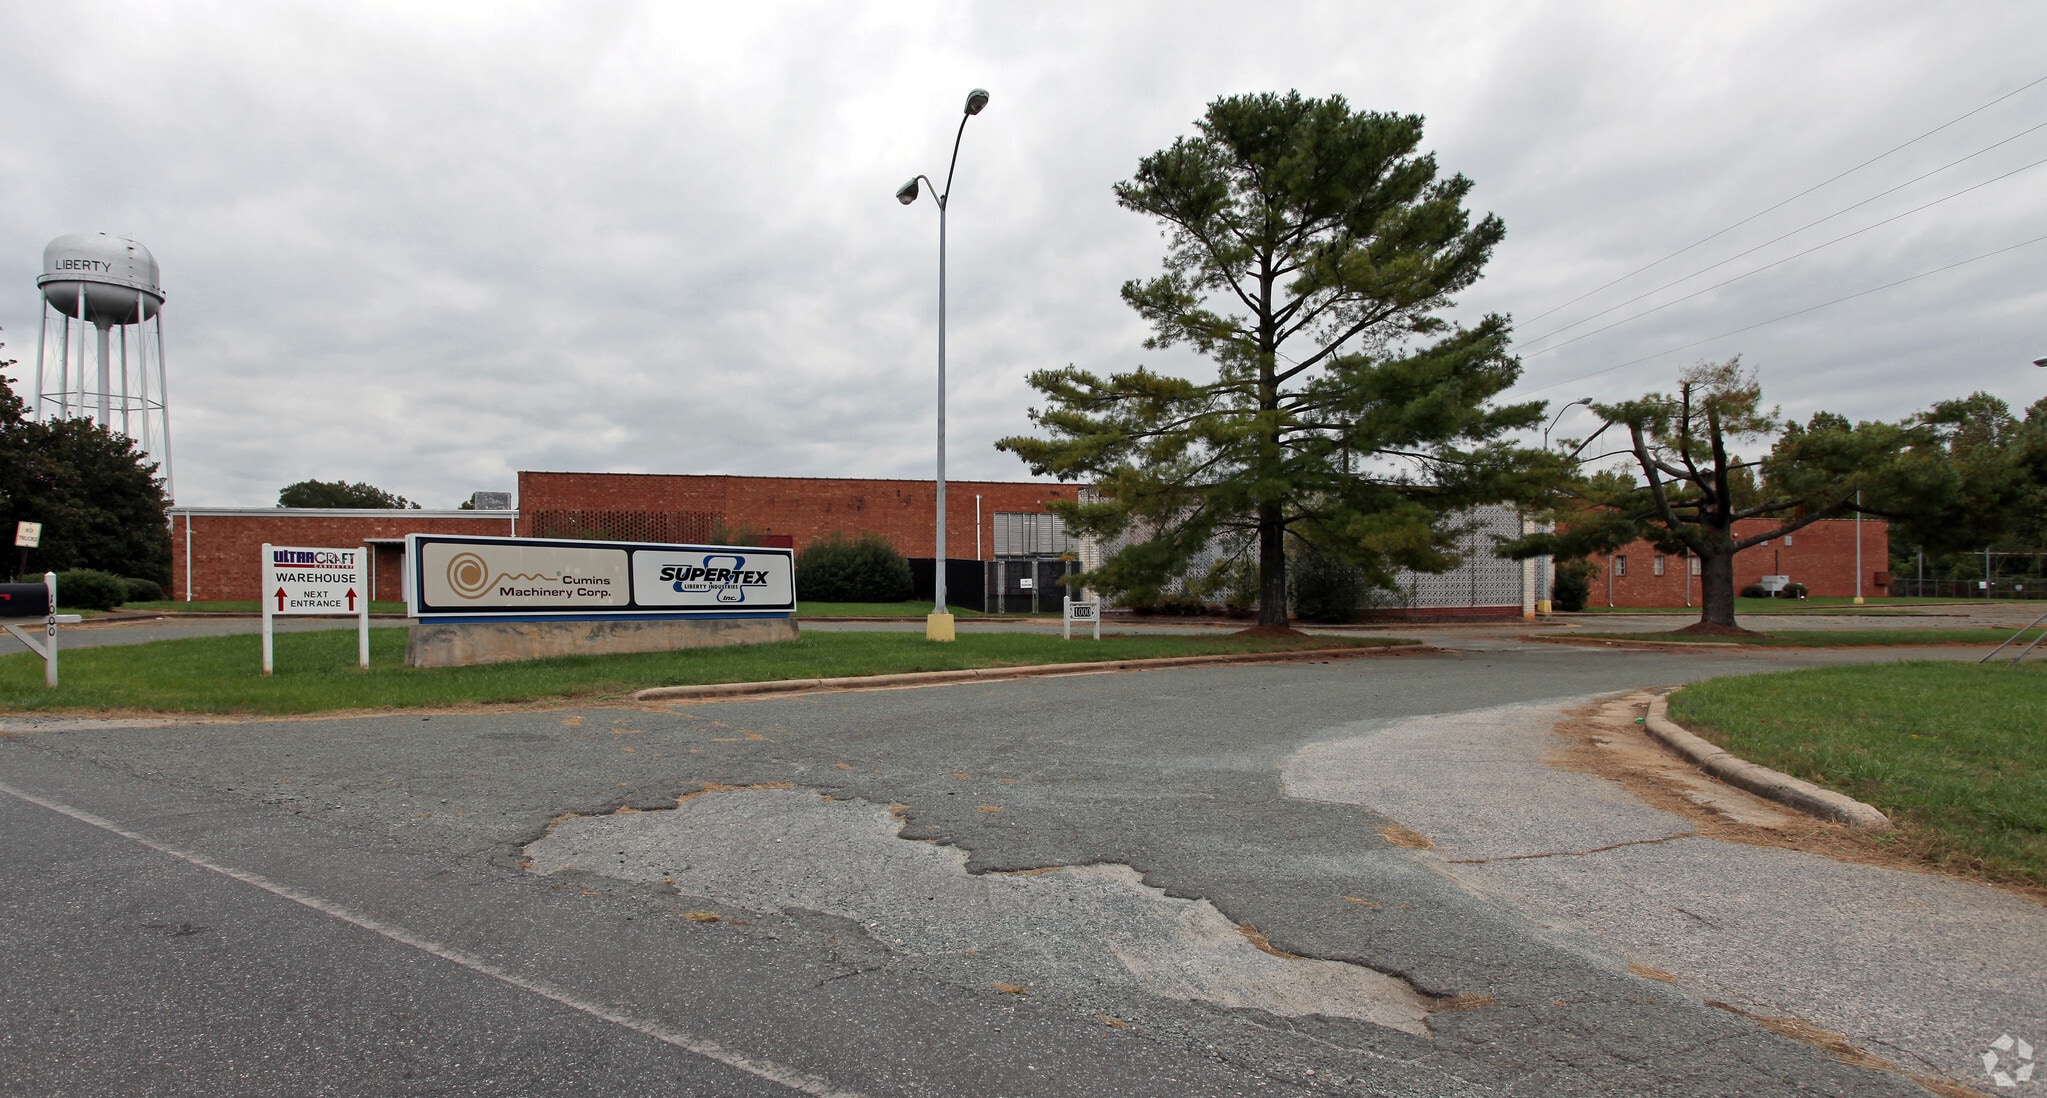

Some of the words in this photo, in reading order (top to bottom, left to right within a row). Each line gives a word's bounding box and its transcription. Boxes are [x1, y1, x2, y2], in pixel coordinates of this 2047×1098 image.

[55, 259, 112, 272] LIBERTY
[276, 573, 356, 583] WAREHOUSE
[562, 575, 611, 585] Cumins
[659, 566, 769, 584] SUPERTEX
[500, 587, 573, 598] Machinery
[577, 587, 611, 598] Corp.
[1074, 607, 1092, 617] 1000
